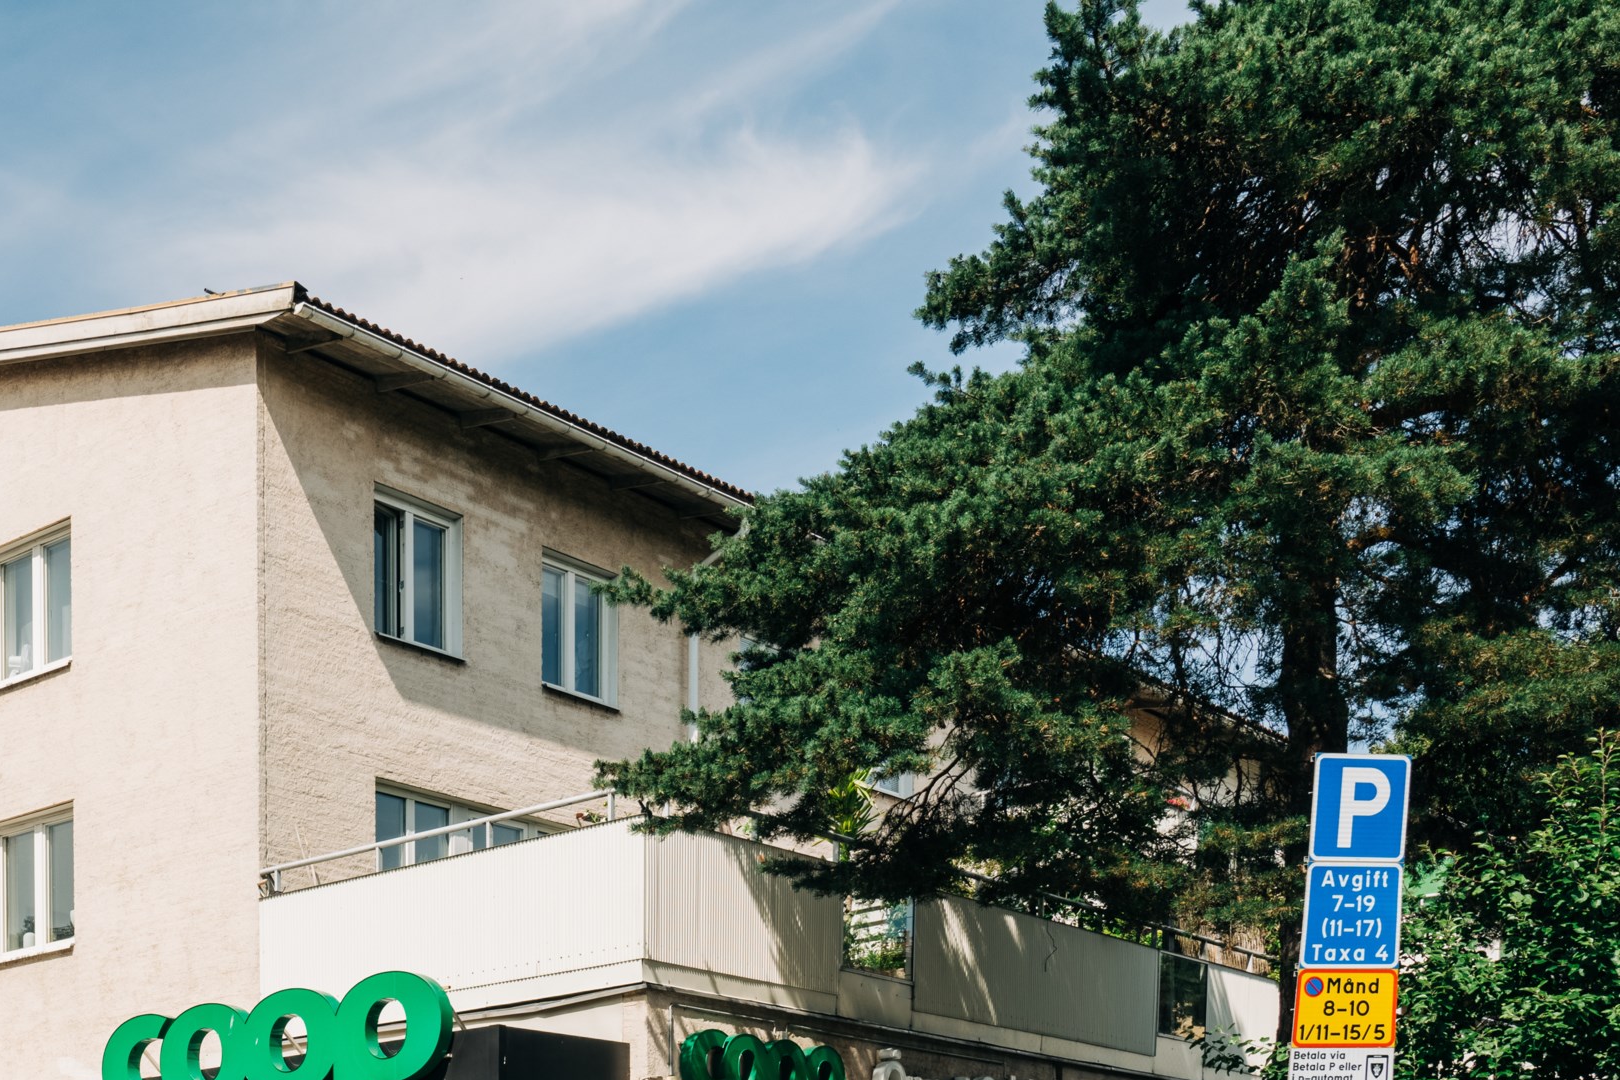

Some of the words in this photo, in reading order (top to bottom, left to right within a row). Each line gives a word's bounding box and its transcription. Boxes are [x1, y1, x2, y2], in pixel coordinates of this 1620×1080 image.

[1336, 767, 1391, 848] P
[1321, 870, 1388, 892] Avgift
[1332, 895, 1375, 912] 7-19
[1321, 917, 1382, 938] (11-17)
[1312, 944, 1365, 962] Taxa
[1375, 944, 1388, 961] 4
[1326, 978, 1379, 994] Månd
[1323, 1000, 1370, 1016] 8-10
[1299, 1024, 1385, 1040] 1/11-15/5
[1293, 1051, 1326, 1060] Betala
[1330, 1051, 1346, 1060] via
[1292, 1062, 1325, 1071] Betala
[1329, 1062, 1336, 1071] P
[1338, 1062, 1362, 1071] eller
